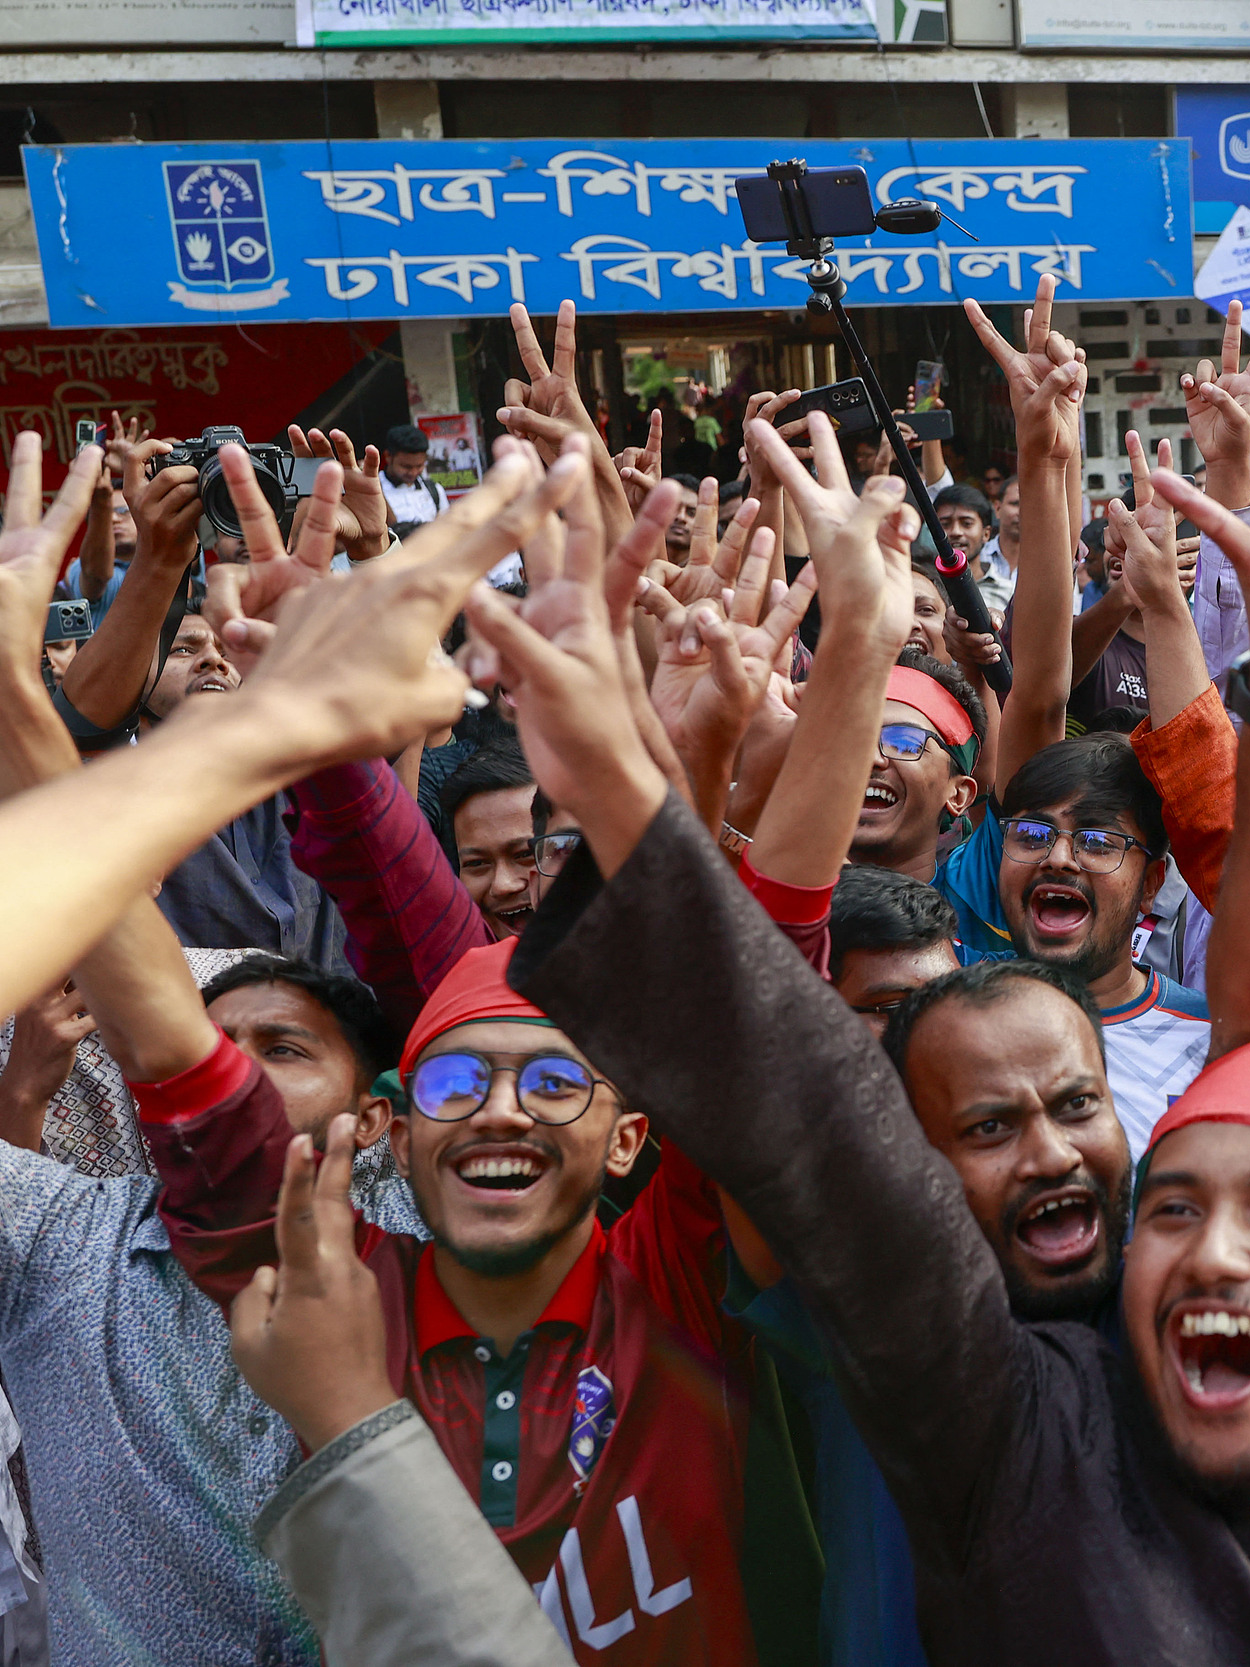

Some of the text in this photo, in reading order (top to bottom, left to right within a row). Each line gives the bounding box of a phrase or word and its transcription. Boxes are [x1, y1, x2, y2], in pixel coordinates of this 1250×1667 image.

[302, 150, 1090, 227] ছাত্র-শিক্ষ কেন্দ্র
[304, 247, 541, 307] ঢাকা
